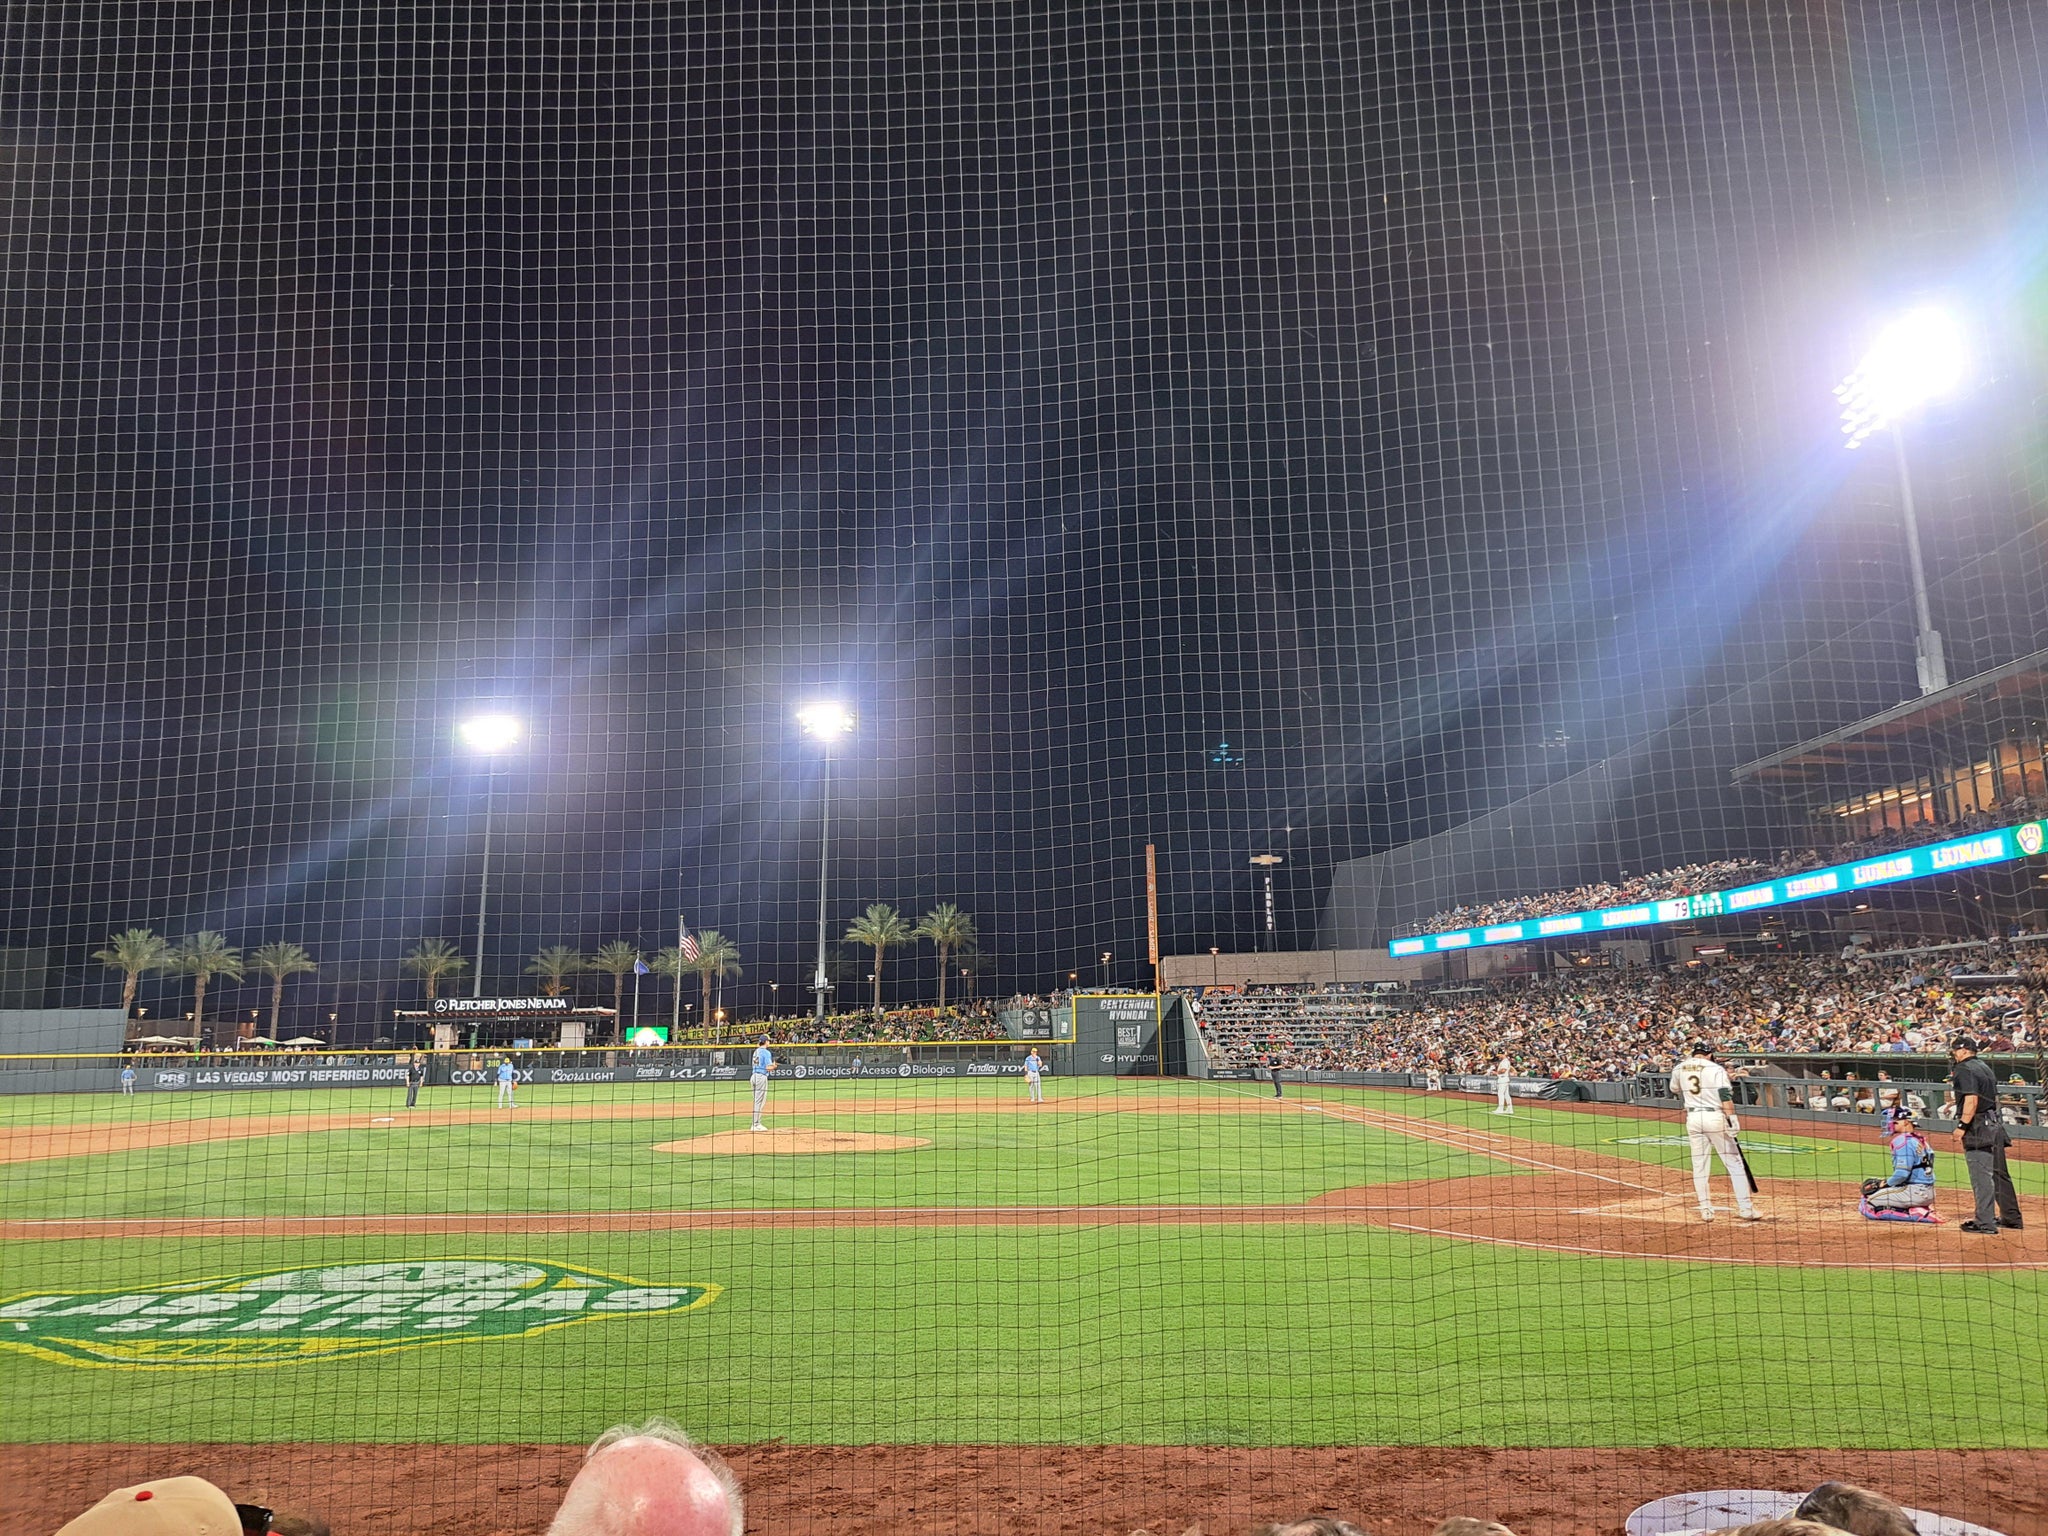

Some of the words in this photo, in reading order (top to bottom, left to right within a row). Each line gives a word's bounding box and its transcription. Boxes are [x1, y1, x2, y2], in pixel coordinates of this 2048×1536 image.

[1674, 902, 1688, 918] 79
[449, 999, 496, 1011] FLETCHER
[496, 998, 527, 1012] JONES
[527, 997, 567, 1009] NEVADA
[1100, 999, 1154, 1010] CENTENNIAL
[1109, 1010, 1148, 1020] HYUNDAI
[552, 1069, 585, 1082] Coors
[586, 1072, 615, 1081] LIGHT
[636, 1067, 663, 1077] Findlay
[711, 1066, 738, 1076] Findlay
[808, 1065, 851, 1078] Biologics
[861, 1065, 896, 1075] Acesso
[912, 1064, 955, 1077] Biologics
[966, 1063, 999, 1075] Findlay
[196, 1072, 220, 1083] LAS
[223, 1071, 269, 1083] VEGAS'
[271, 1070, 306, 1082] MOST
[309, 1069, 370, 1081] REFERRED
[452, 1070, 487, 1084] COX
[510, 1069, 534, 1082] OX
[1688, 1075, 1701, 1095] 3
[0, 1293, 260, 1317] LAS
[255, 1288, 688, 1315] VEGAS
[95, 1315, 479, 1332] SERIES
